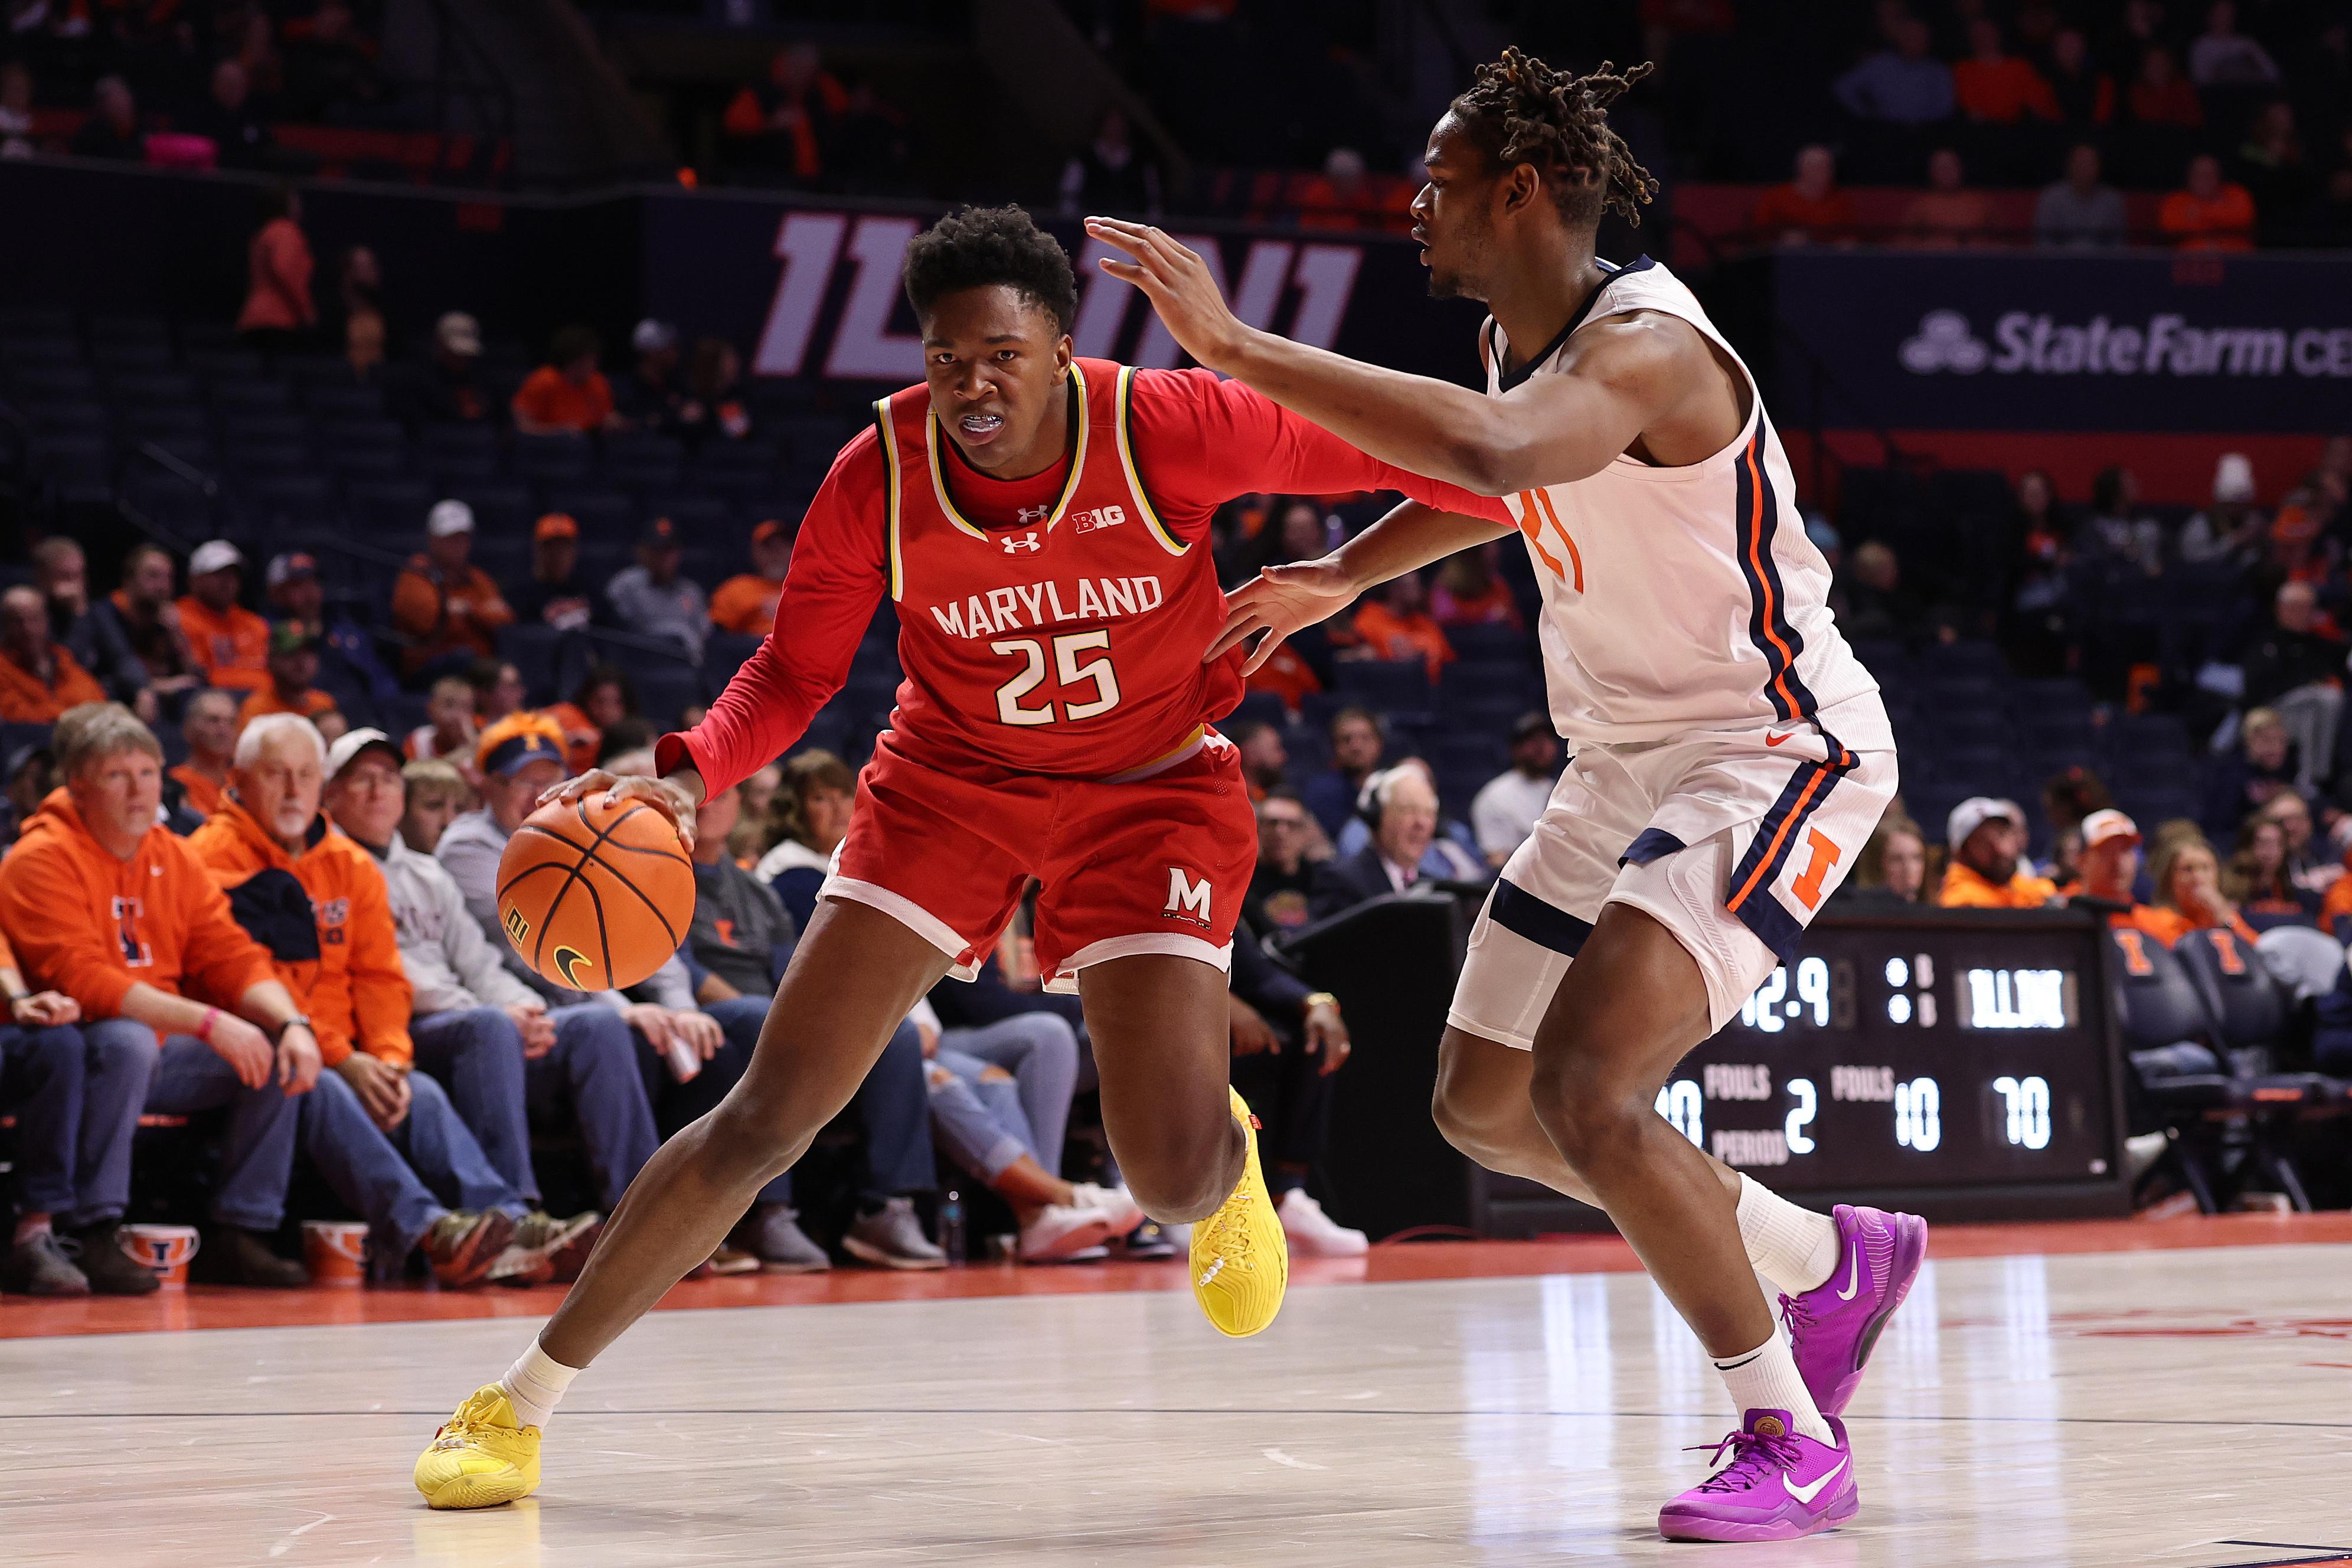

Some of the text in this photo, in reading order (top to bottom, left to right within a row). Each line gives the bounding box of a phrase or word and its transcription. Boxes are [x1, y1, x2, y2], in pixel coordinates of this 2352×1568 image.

[753, 211, 1364, 381] ILINI
[930, 576, 1163, 639] MARYLAND
[990, 628, 1121, 726] 25
[1163, 866, 1213, 923] M
[1703, 1063, 1772, 1101] FOULS
[1785, 1078, 1817, 1154] 2
[1830, 1065, 1895, 1102] FOULS
[1894, 1077, 1941, 1152] 10
[1992, 1076, 2052, 1149] 70
[1711, 1129, 1789, 1167] PERIOD
